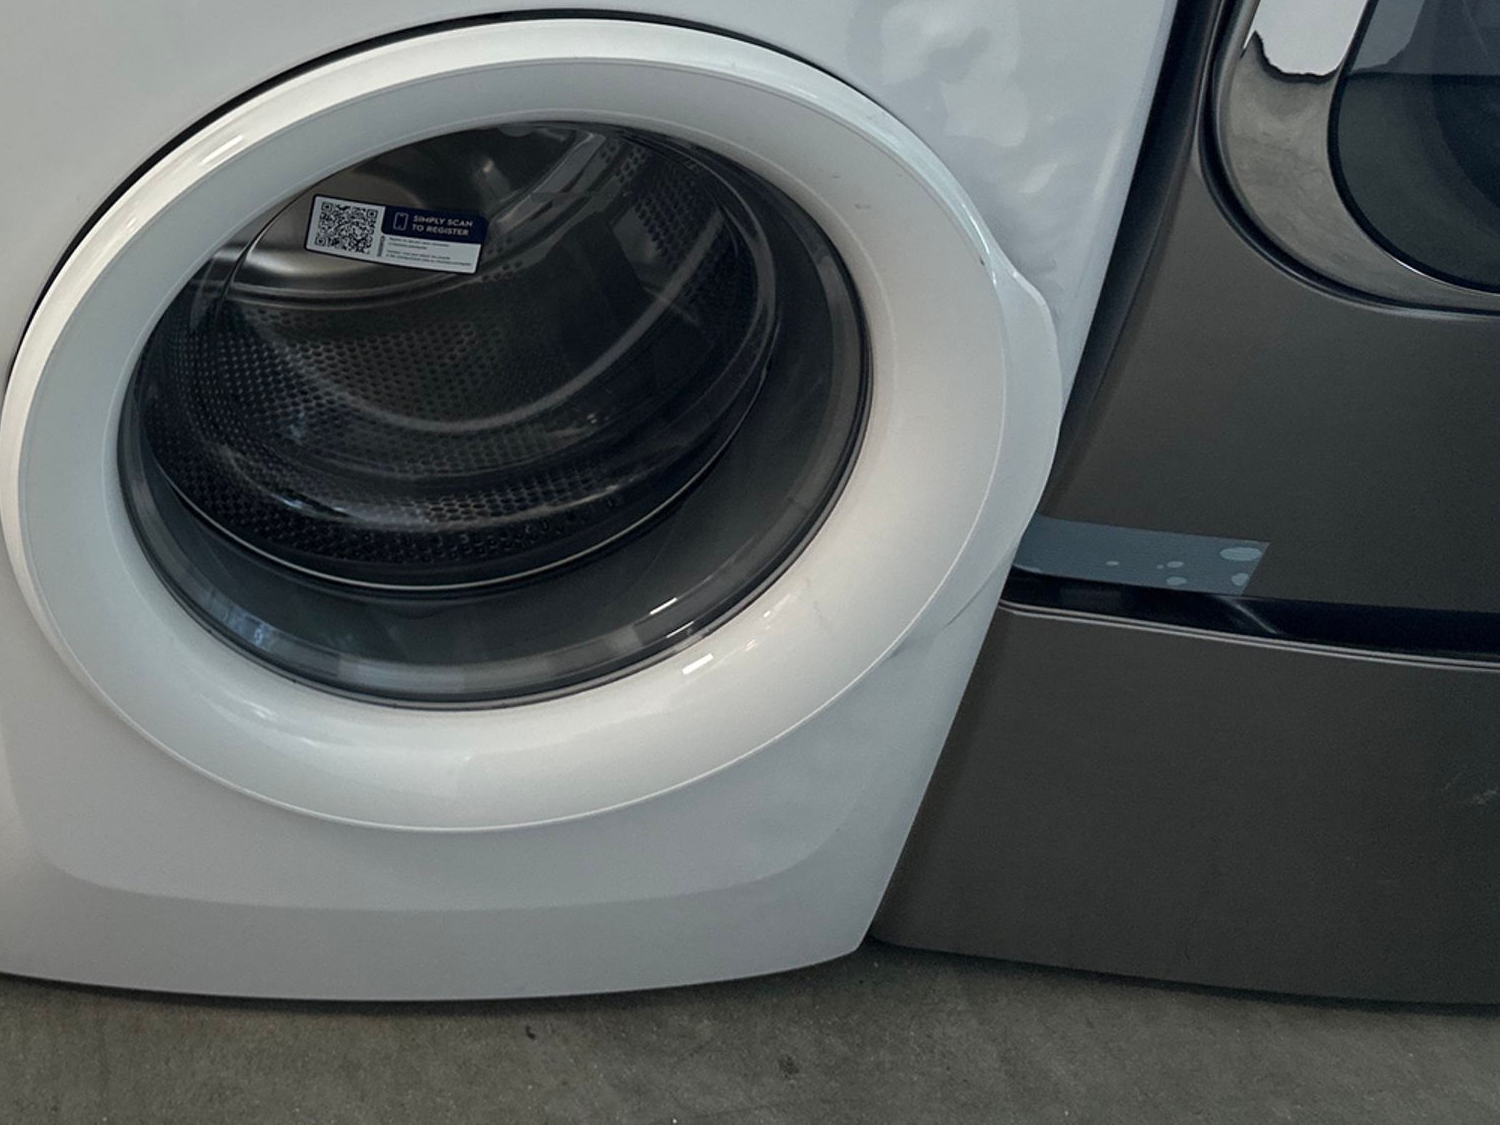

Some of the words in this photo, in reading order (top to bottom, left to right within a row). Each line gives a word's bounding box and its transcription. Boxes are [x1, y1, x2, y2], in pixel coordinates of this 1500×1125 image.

[413, 215, 445, 225] SIMPLY
[447, 218, 473, 227] SCAN
[426, 225, 469, 236] REGISTER
